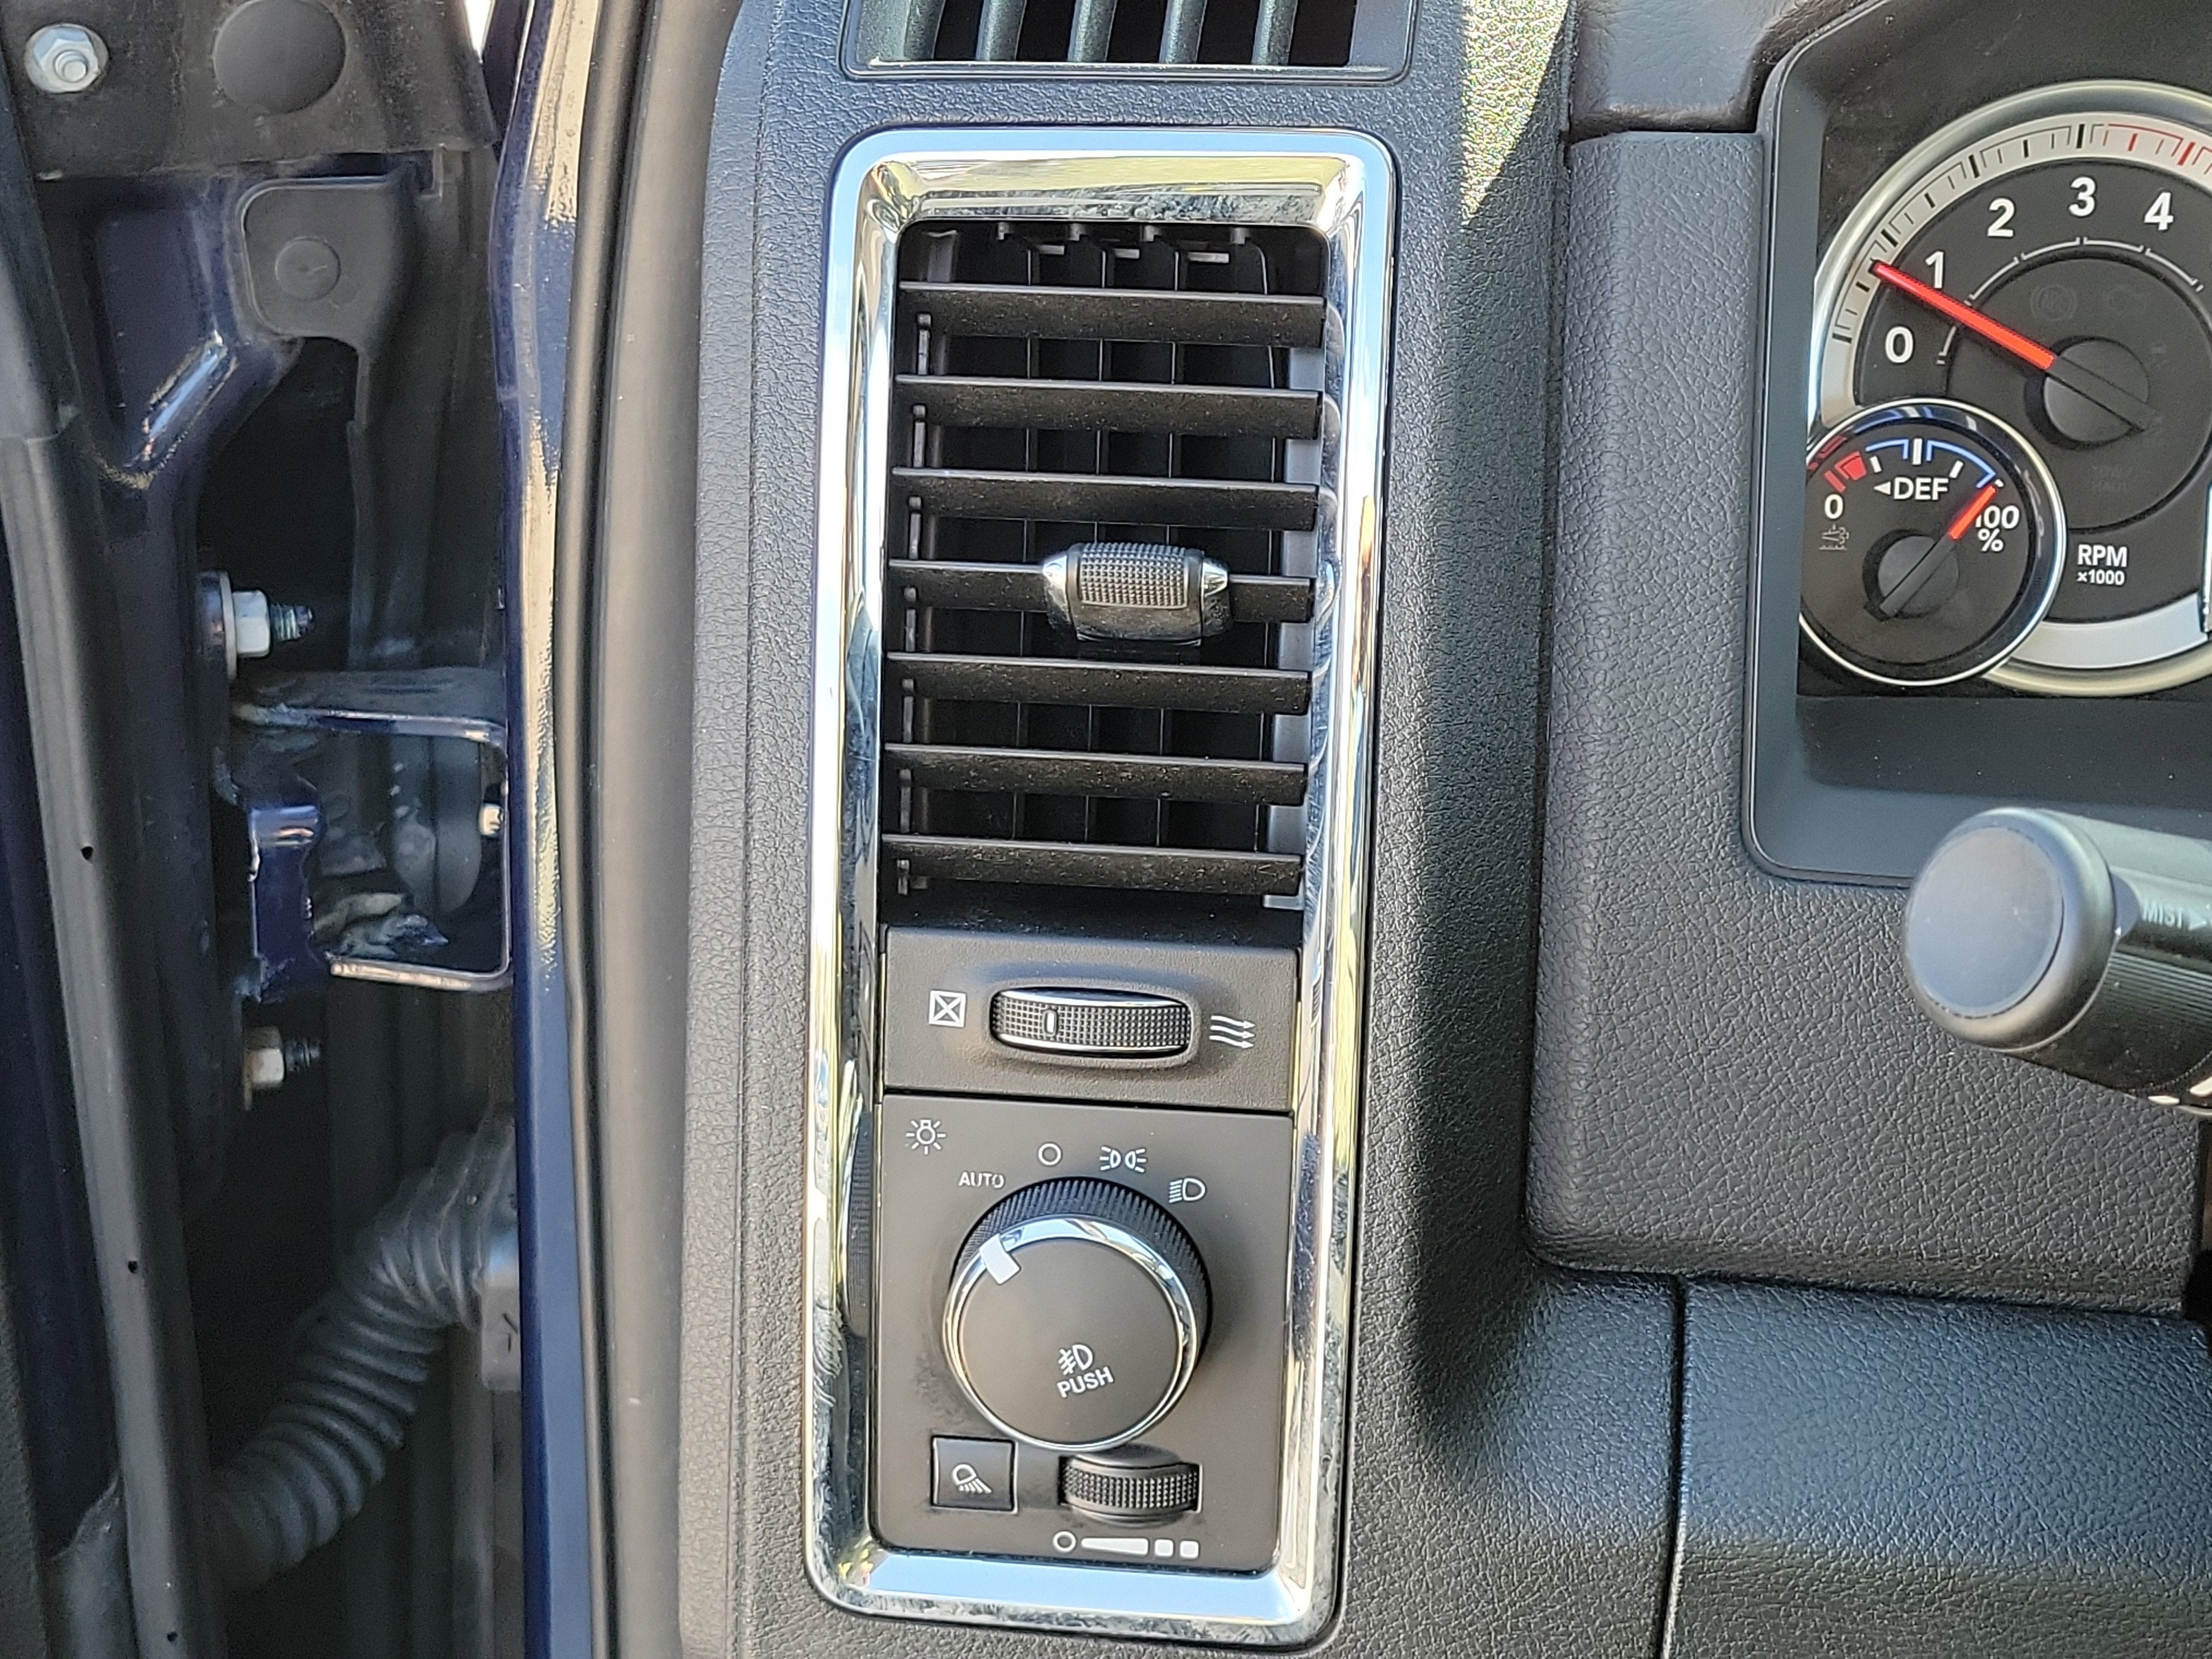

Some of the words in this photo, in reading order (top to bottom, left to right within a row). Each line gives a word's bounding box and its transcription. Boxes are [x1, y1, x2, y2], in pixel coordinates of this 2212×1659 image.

[2069, 177, 2095, 216] 3
[2144, 192, 2174, 230] 4
[1987, 198, 2015, 237] 2
[1925, 251, 1944, 289] 1
[1885, 326, 1913, 363] 0
[1894, 477, 1949, 500] DEF
[1824, 494, 1843, 519] 0
[1978, 528, 2004, 551] %
[2078, 544, 2127, 567] RPM
[958, 1172, 1004, 1188] AUTO
[1057, 1367, 1114, 1398] PUSH
